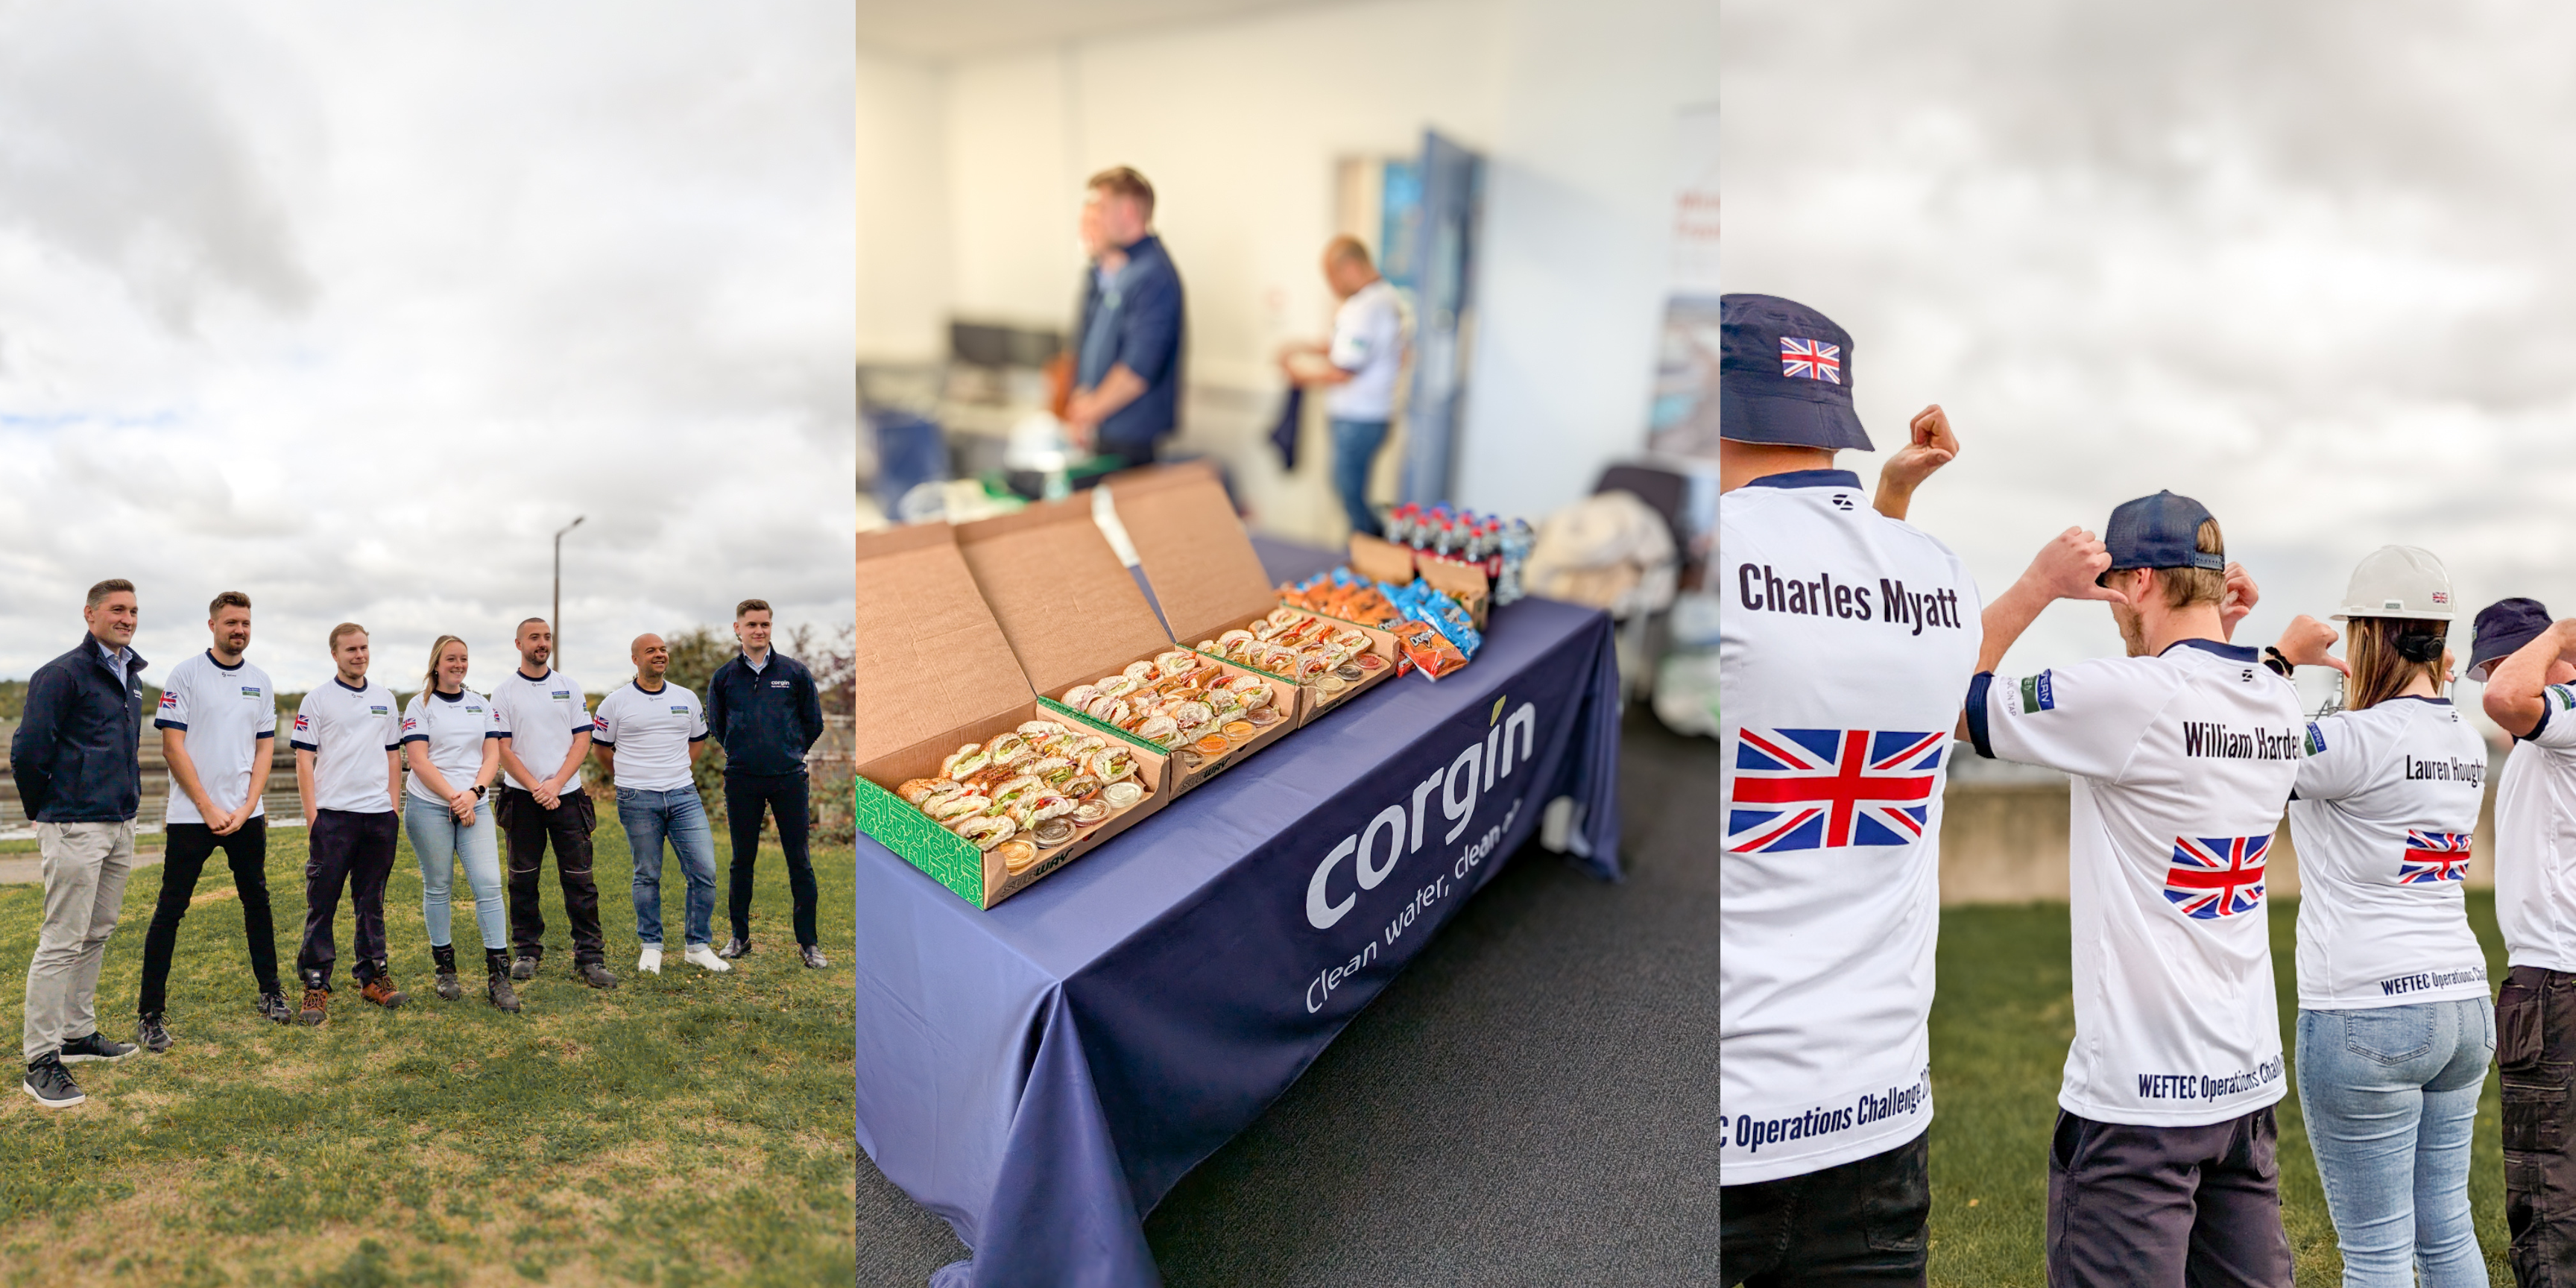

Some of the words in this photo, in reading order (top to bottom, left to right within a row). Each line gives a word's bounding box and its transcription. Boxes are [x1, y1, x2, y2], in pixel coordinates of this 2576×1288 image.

[1738, 563, 1872, 622] Charles
[1880, 578, 1961, 636] Myatt
[2182, 722, 2253, 759] William
[2406, 754, 2450, 781] Lauren
[1306, 694, 1535, 929] corgin
[1306, 940, 1377, 1014] Clean
[1385, 874, 1450, 945] water,
[1455, 824, 1500, 880] clean
[2380, 974, 2431, 996] WEFTEC
[2431, 969, 2475, 989] Operations
[2138, 1074, 2197, 1099] WEFTEC
[2201, 1070, 2259, 1102] Operations
[1736, 1107, 1853, 1153] Operations
[1857, 1082, 1921, 1126] Challenge
